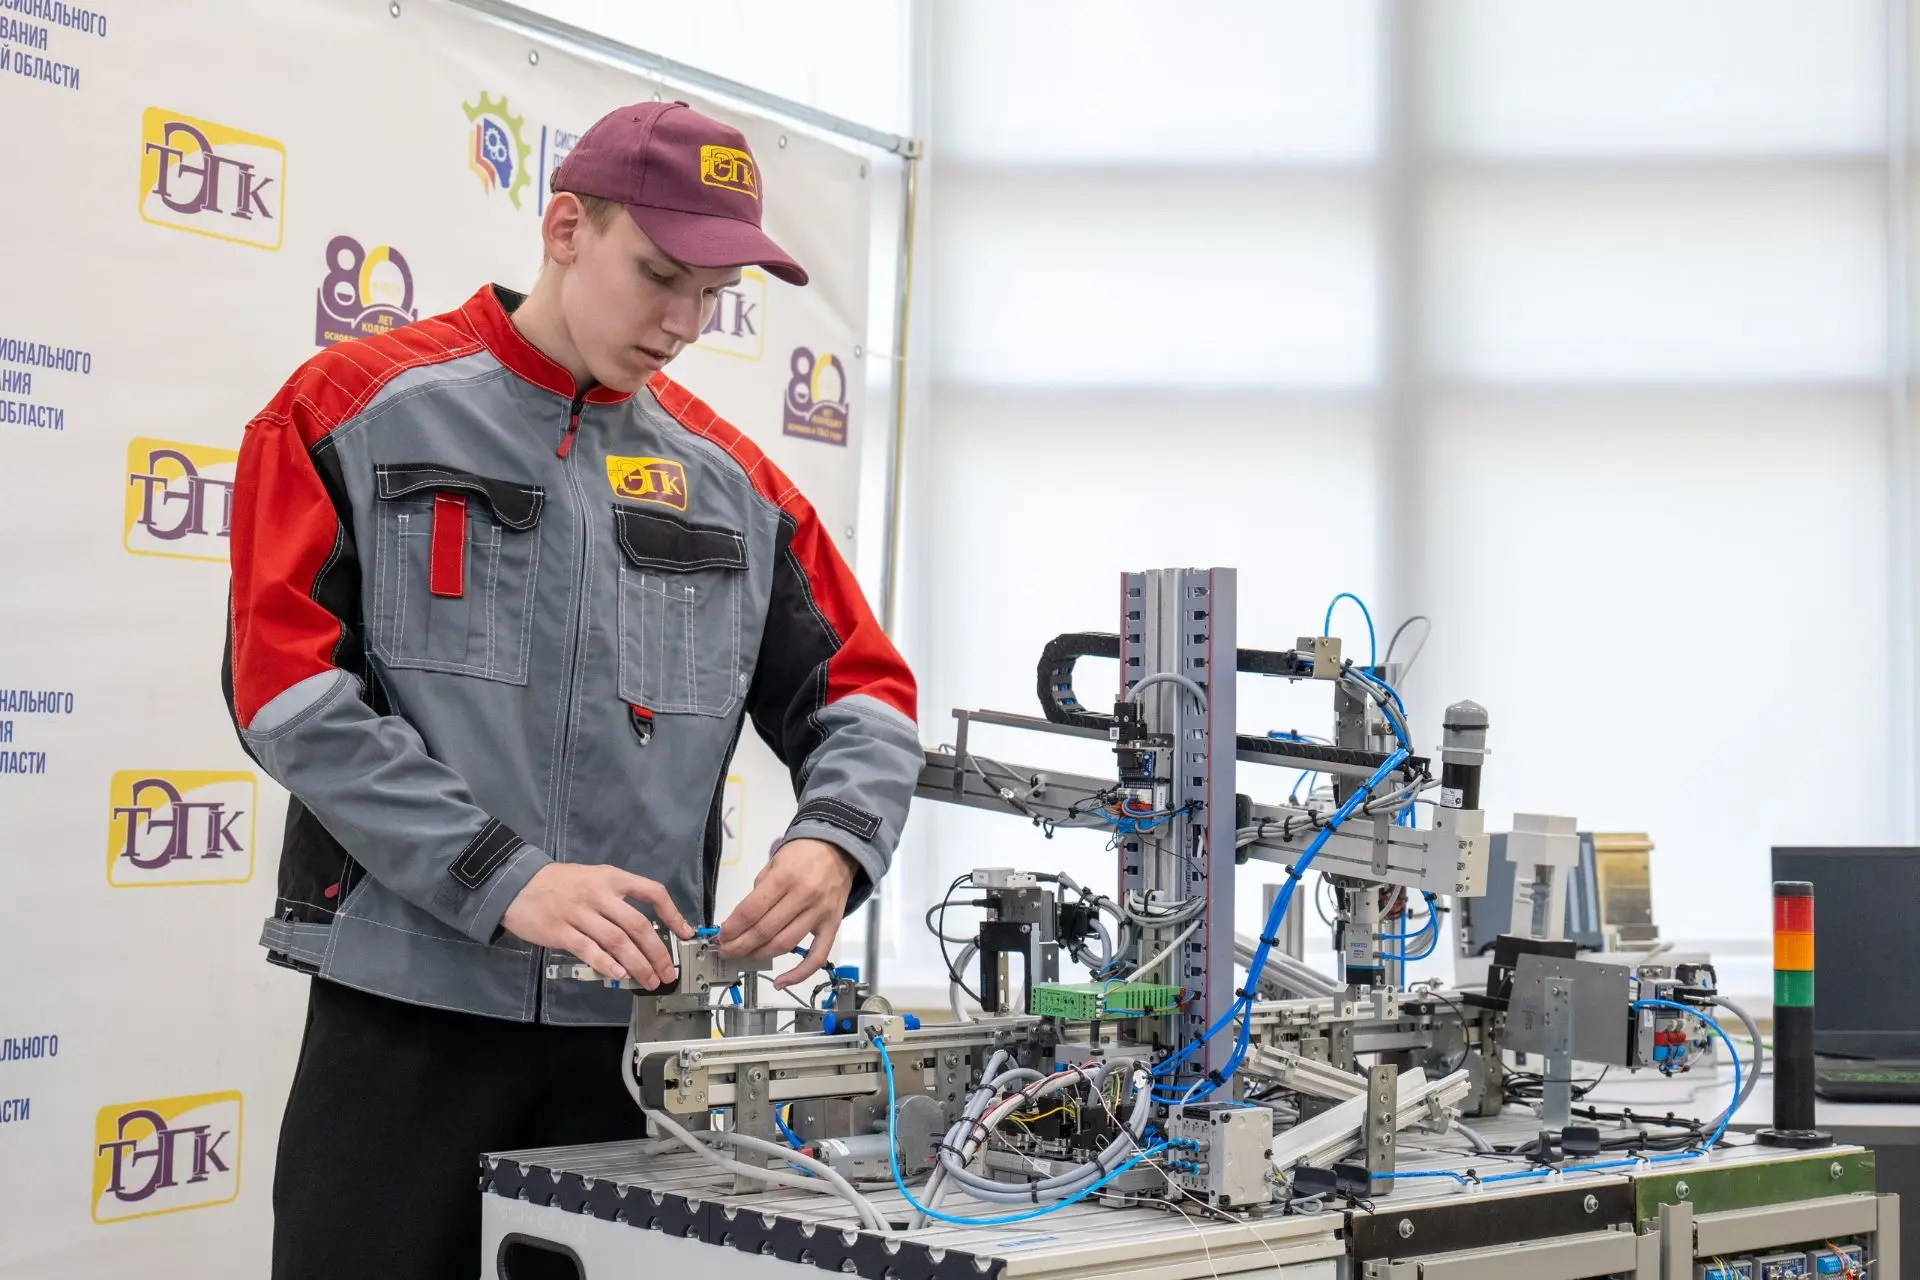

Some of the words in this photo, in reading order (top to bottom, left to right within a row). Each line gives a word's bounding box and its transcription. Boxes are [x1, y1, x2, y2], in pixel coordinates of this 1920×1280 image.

[0, 0, 107, 37] ИОНАЛЬНОГО
[14, 51, 80, 90] ОБЛАСТИ
[555, 129, 580, 150] СИСТ
[145, 122, 274, 220] ТЭПК
[702, 148, 755, 187] ТЭПК
[322, 235, 414, 320] 80
[0, 369, 31, 395] НИЯ
[788, 346, 846, 413] 80
[0, 399, 64, 431] ОБЛАСТИ
[130, 449, 233, 541] ТЭП
[0, 689, 74, 714] НАЛЬНОГО
[0, 751, 46, 774] ЛАСТИ
[114, 778, 245, 870] ТЭПК
[0, 1034, 58, 1062] ЛЬНОГО
[0, 1098, 30, 1123] СТИ
[99, 1109, 231, 1202] ТЭПК
